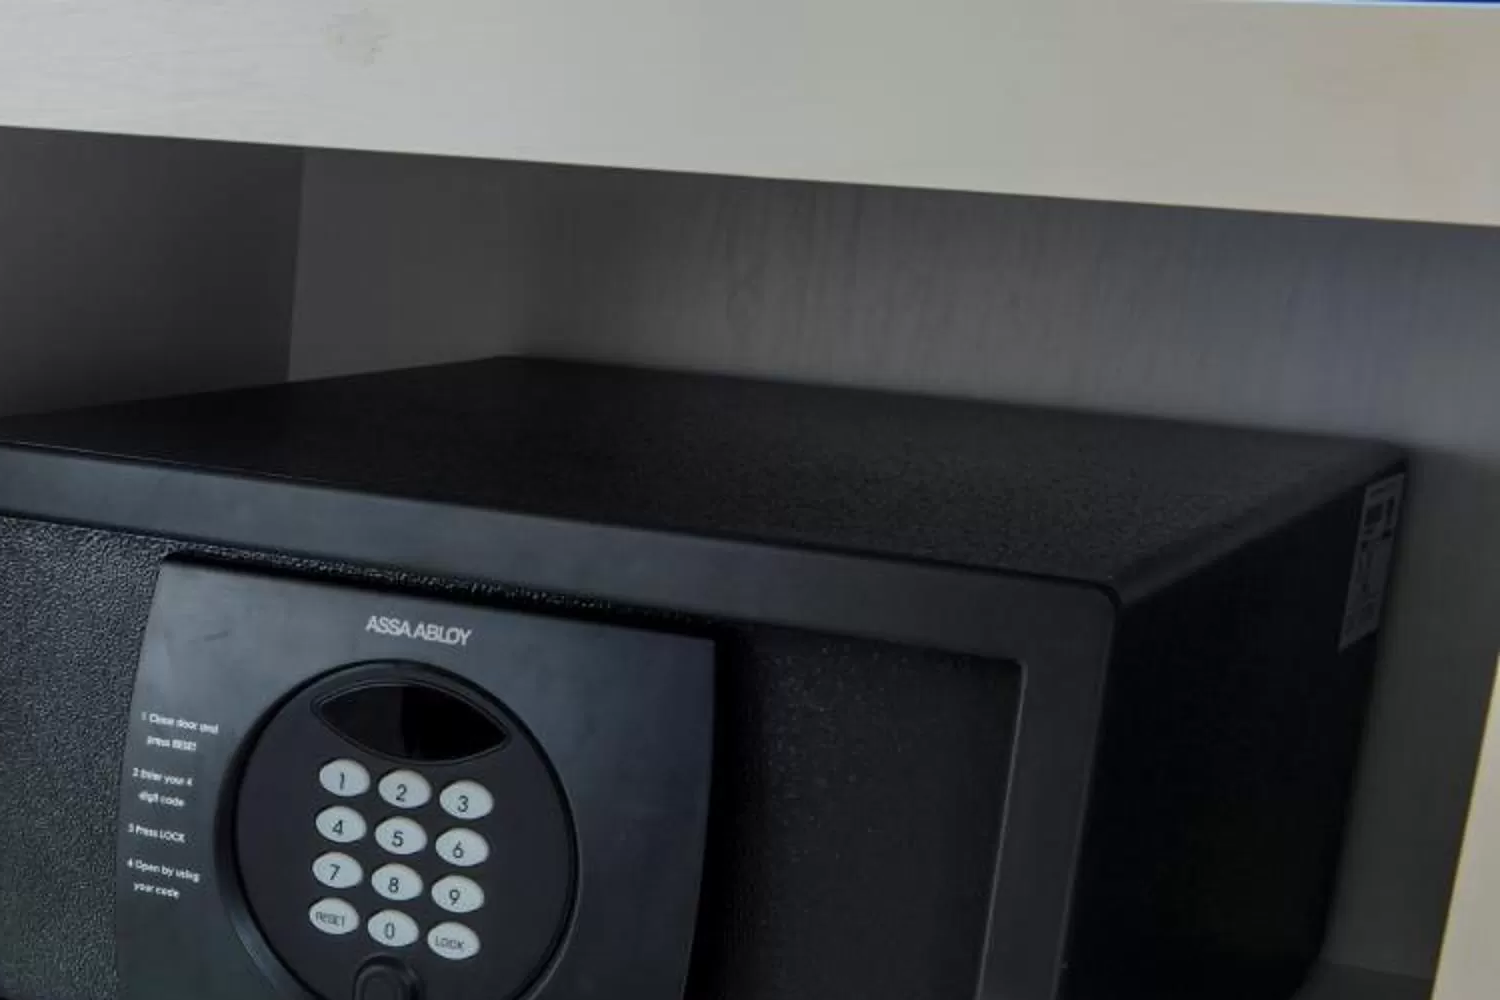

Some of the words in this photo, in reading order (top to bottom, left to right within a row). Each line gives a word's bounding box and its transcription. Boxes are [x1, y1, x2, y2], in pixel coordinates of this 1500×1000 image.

[364, 615, 411, 639] ASSA
[412, 621, 473, 646] ABLOY
[176, 718, 198, 731] door
[160, 795, 185, 807] code
[338, 771, 346, 790] 1
[396, 783, 407, 802] 2
[457, 795, 469, 813] 3
[135, 824, 158, 838] Press
[159, 829, 186, 843] LOCK
[332, 819, 344, 836] 4
[391, 830, 405, 847] 5
[452, 841, 464, 859] 6
[135, 859, 160, 873] Open
[161, 864, 174, 878] by
[155, 886, 181, 899] code
[329, 863, 341, 881] 7
[388, 877, 400, 894] 8
[449, 889, 461, 906] 9
[315, 911, 345, 927] RESET
[384, 922, 396, 940] 0
[435, 936, 466, 951] LOCK
